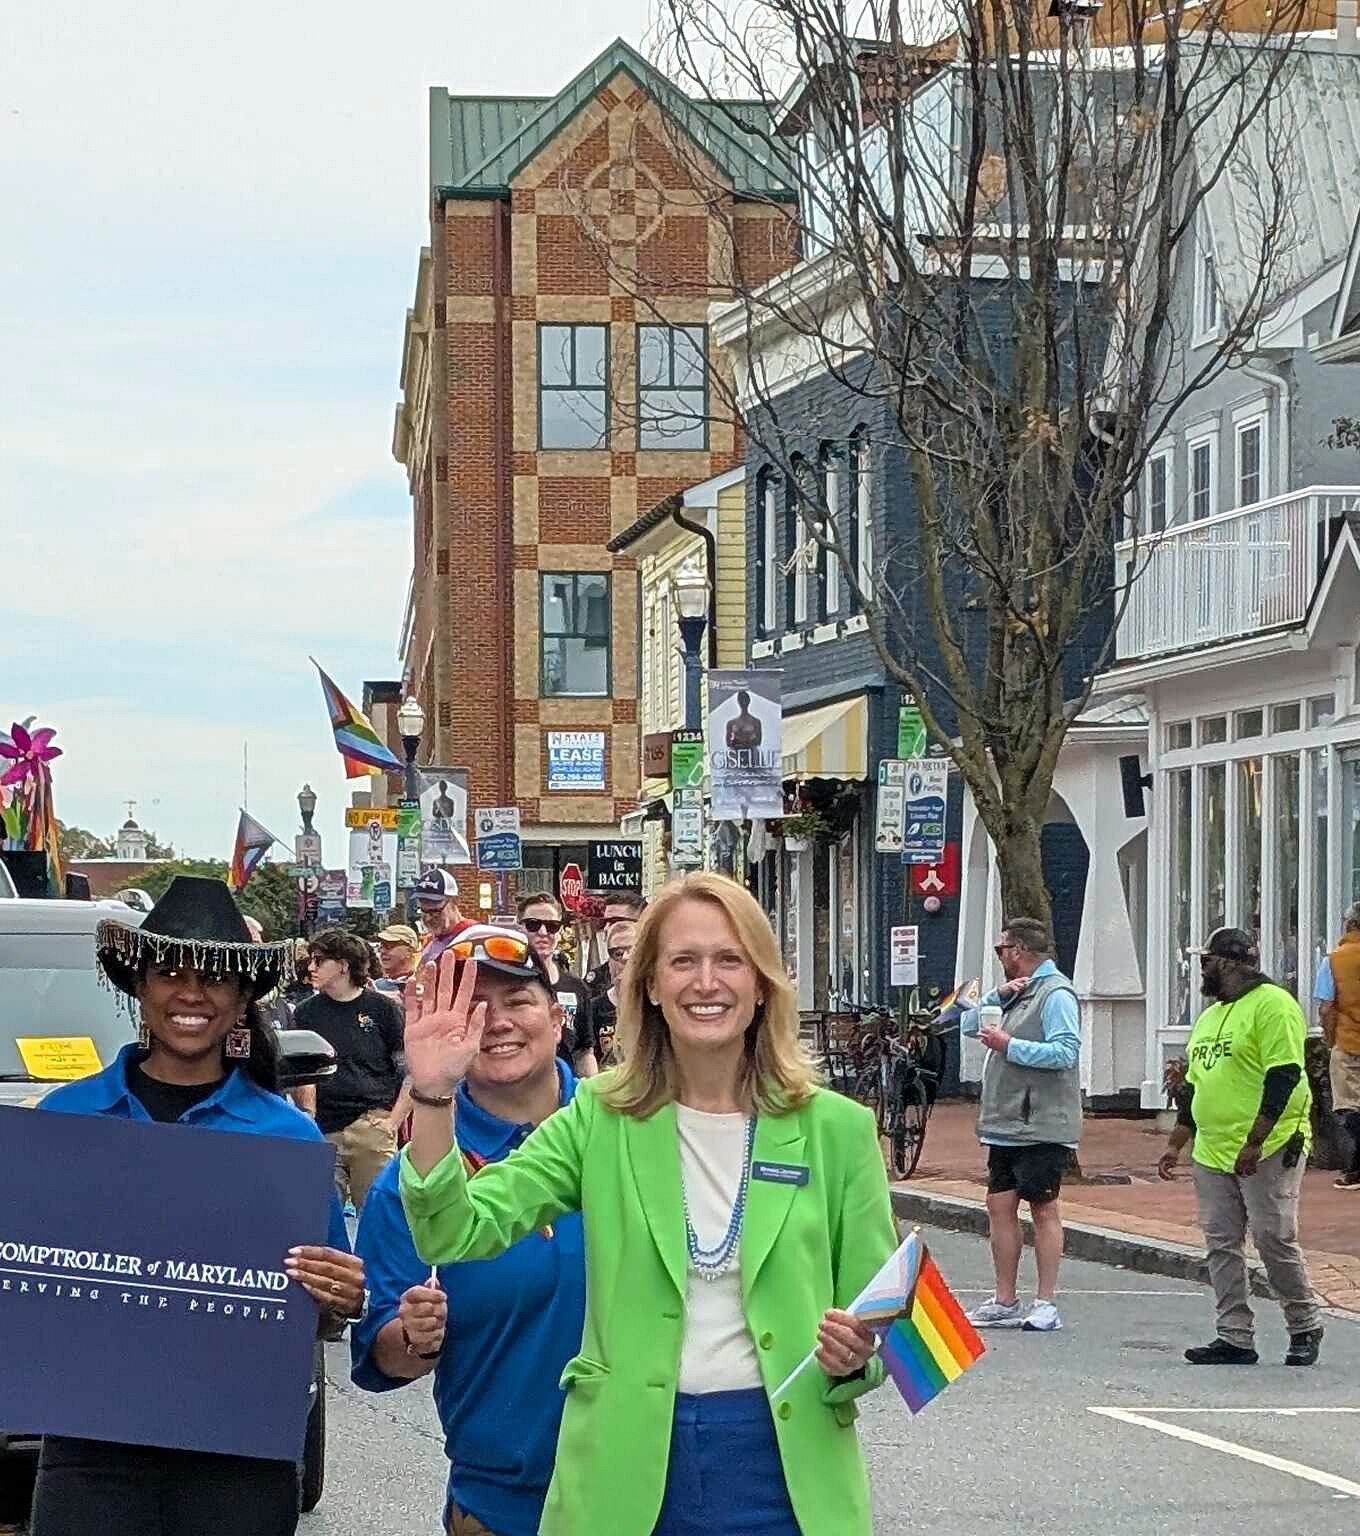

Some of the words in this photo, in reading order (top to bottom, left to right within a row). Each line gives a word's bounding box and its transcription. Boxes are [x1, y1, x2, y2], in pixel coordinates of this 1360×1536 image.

[550, 749, 603, 761] LEASE
[596, 844, 641, 858] LUNCH
[598, 872, 639, 886] BACK!
[562, 878, 583, 897] STOP
[146, 1260, 161, 1277] of
[163, 1260, 290, 1291] MARYLAND
[120, 1292, 168, 1308] THE
[189, 1299, 286, 1321] PEOPLE
